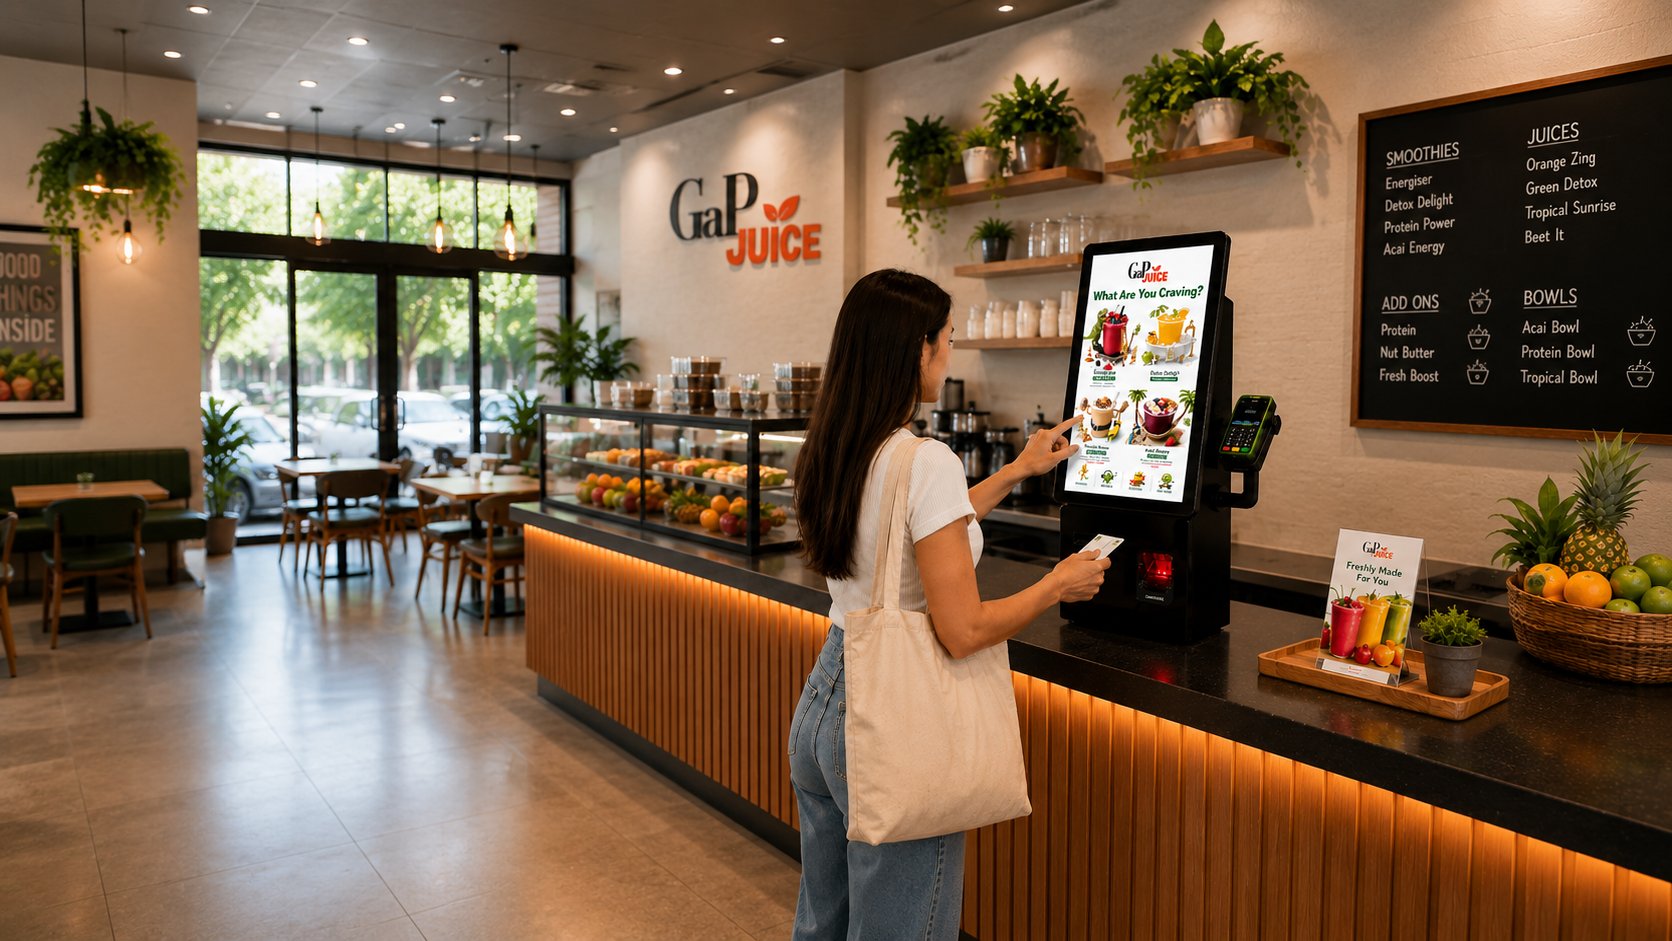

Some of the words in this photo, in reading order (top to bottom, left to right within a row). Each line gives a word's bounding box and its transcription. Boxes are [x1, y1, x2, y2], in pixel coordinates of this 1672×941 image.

[1527, 121, 1579, 145] JUICES
[1386, 141, 1460, 167] SMOOTHIES
[1526, 157, 1566, 171] Orange
[1571, 151, 1596, 167] Zing
[1385, 174, 1432, 190] Energiser
[1526, 181, 1559, 195] Green
[1564, 176, 1598, 191] Detox
[670, 172, 759, 241] GaP
[1385, 198, 1414, 212] Detox
[1417, 193, 1453, 210] Delight
[1525, 202, 1568, 222] Tropical
[1573, 199, 1617, 215] Sunrise
[1384, 220, 1419, 234] Protein
[1423, 217, 1455, 230] Power
[726, 223, 821, 266] JUICE
[1525, 230, 1550, 244] Beet
[1555, 228, 1564, 241] It
[1383, 242, 1405, 255] Acai
[1409, 240, 1445, 255] Energy
[1128, 261, 1151, 279] GaP
[1142, 271, 1168, 283] JUICE
[0, 285, 56, 312] HINGS
[1093, 291, 1118, 301] What
[1119, 290, 1136, 300] Are
[1139, 288, 1157, 299] You
[1159, 285, 1204, 299] Craving?
[1523, 288, 1578, 305] BOWLS
[1382, 295, 1408, 311] ADD
[1412, 294, 1439, 310] ONS
[1381, 323, 1416, 337] Protein
[1522, 320, 1547, 334] Acai
[1551, 319, 1580, 333] Bowl
[1380, 346, 1399, 359] Nut
[1402, 346, 1435, 359] Butter
[1521, 344, 1561, 359] Protein
[1566, 344, 1595, 359] Bowl
[1379, 368, 1406, 382] Fresh
[1410, 369, 1439, 383] Boost
[1520, 369, 1564, 388] Tropical
[1569, 370, 1598, 384] Bowl
[1346, 561, 1377, 575] Freshly
[1378, 566, 1402, 578] Made
[1356, 574, 1371, 583] For
[1373, 576, 1389, 586] You
